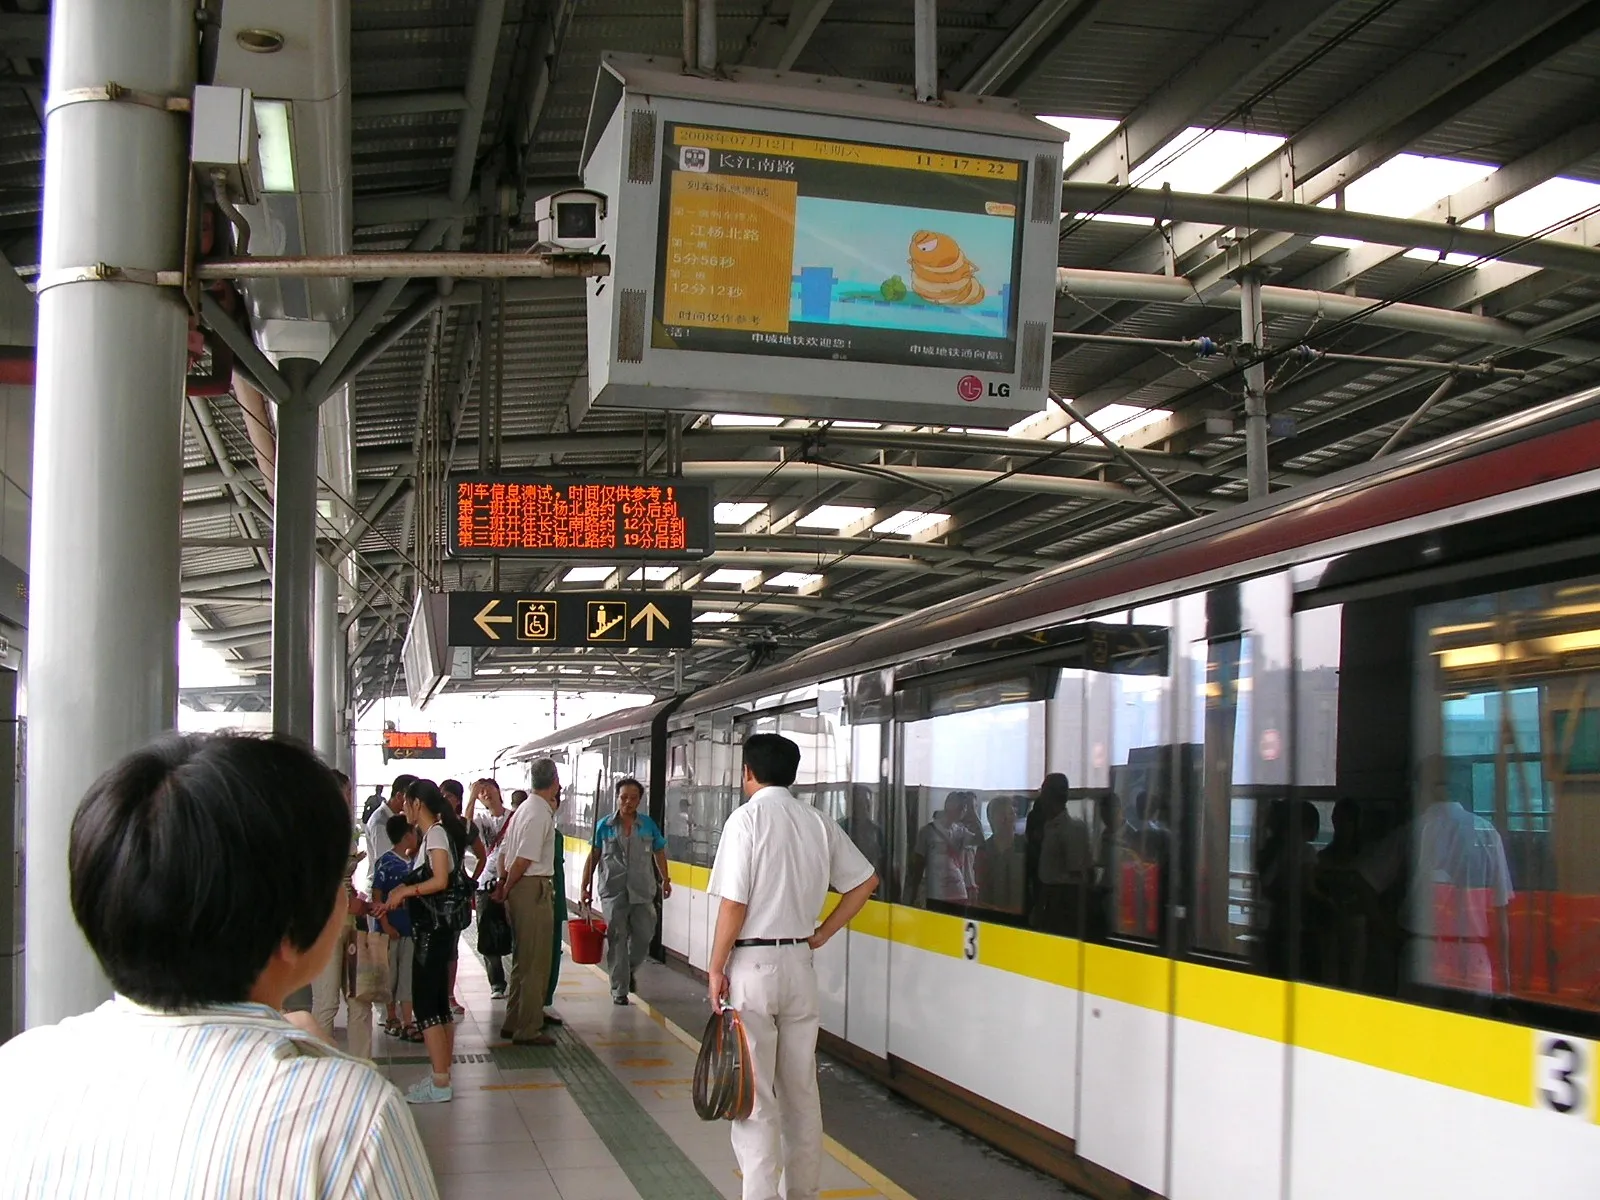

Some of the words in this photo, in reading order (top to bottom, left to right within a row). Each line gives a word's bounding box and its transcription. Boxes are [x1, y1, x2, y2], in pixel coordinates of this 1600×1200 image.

[679, 130, 795, 151] 2008年07月12日
[719, 153, 796, 175] 长江南路
[690, 224, 760, 242] 江杨北路
[672, 252, 737, 269] 5分56秒
[672, 282, 744, 299] 12分12秒
[751, 332, 852, 349] 申城地铁欢迎您！
[988, 382, 1010, 398] LG
[457, 482, 674, 502] 列车信息测试，时间仅供参考！
[457, 499, 616, 518] 第一班开往江杨北路约
[622, 501, 678, 518] 6分后到
[457, 515, 616, 533] 第二班开往长江南路约
[623, 516, 685, 534] 12分后到
[457, 531, 616, 549] 第三班开往江杨北路约
[623, 532, 685, 550] 19分后到
[964, 922, 977, 960] 3
[1539, 1037, 1583, 1114] 3
